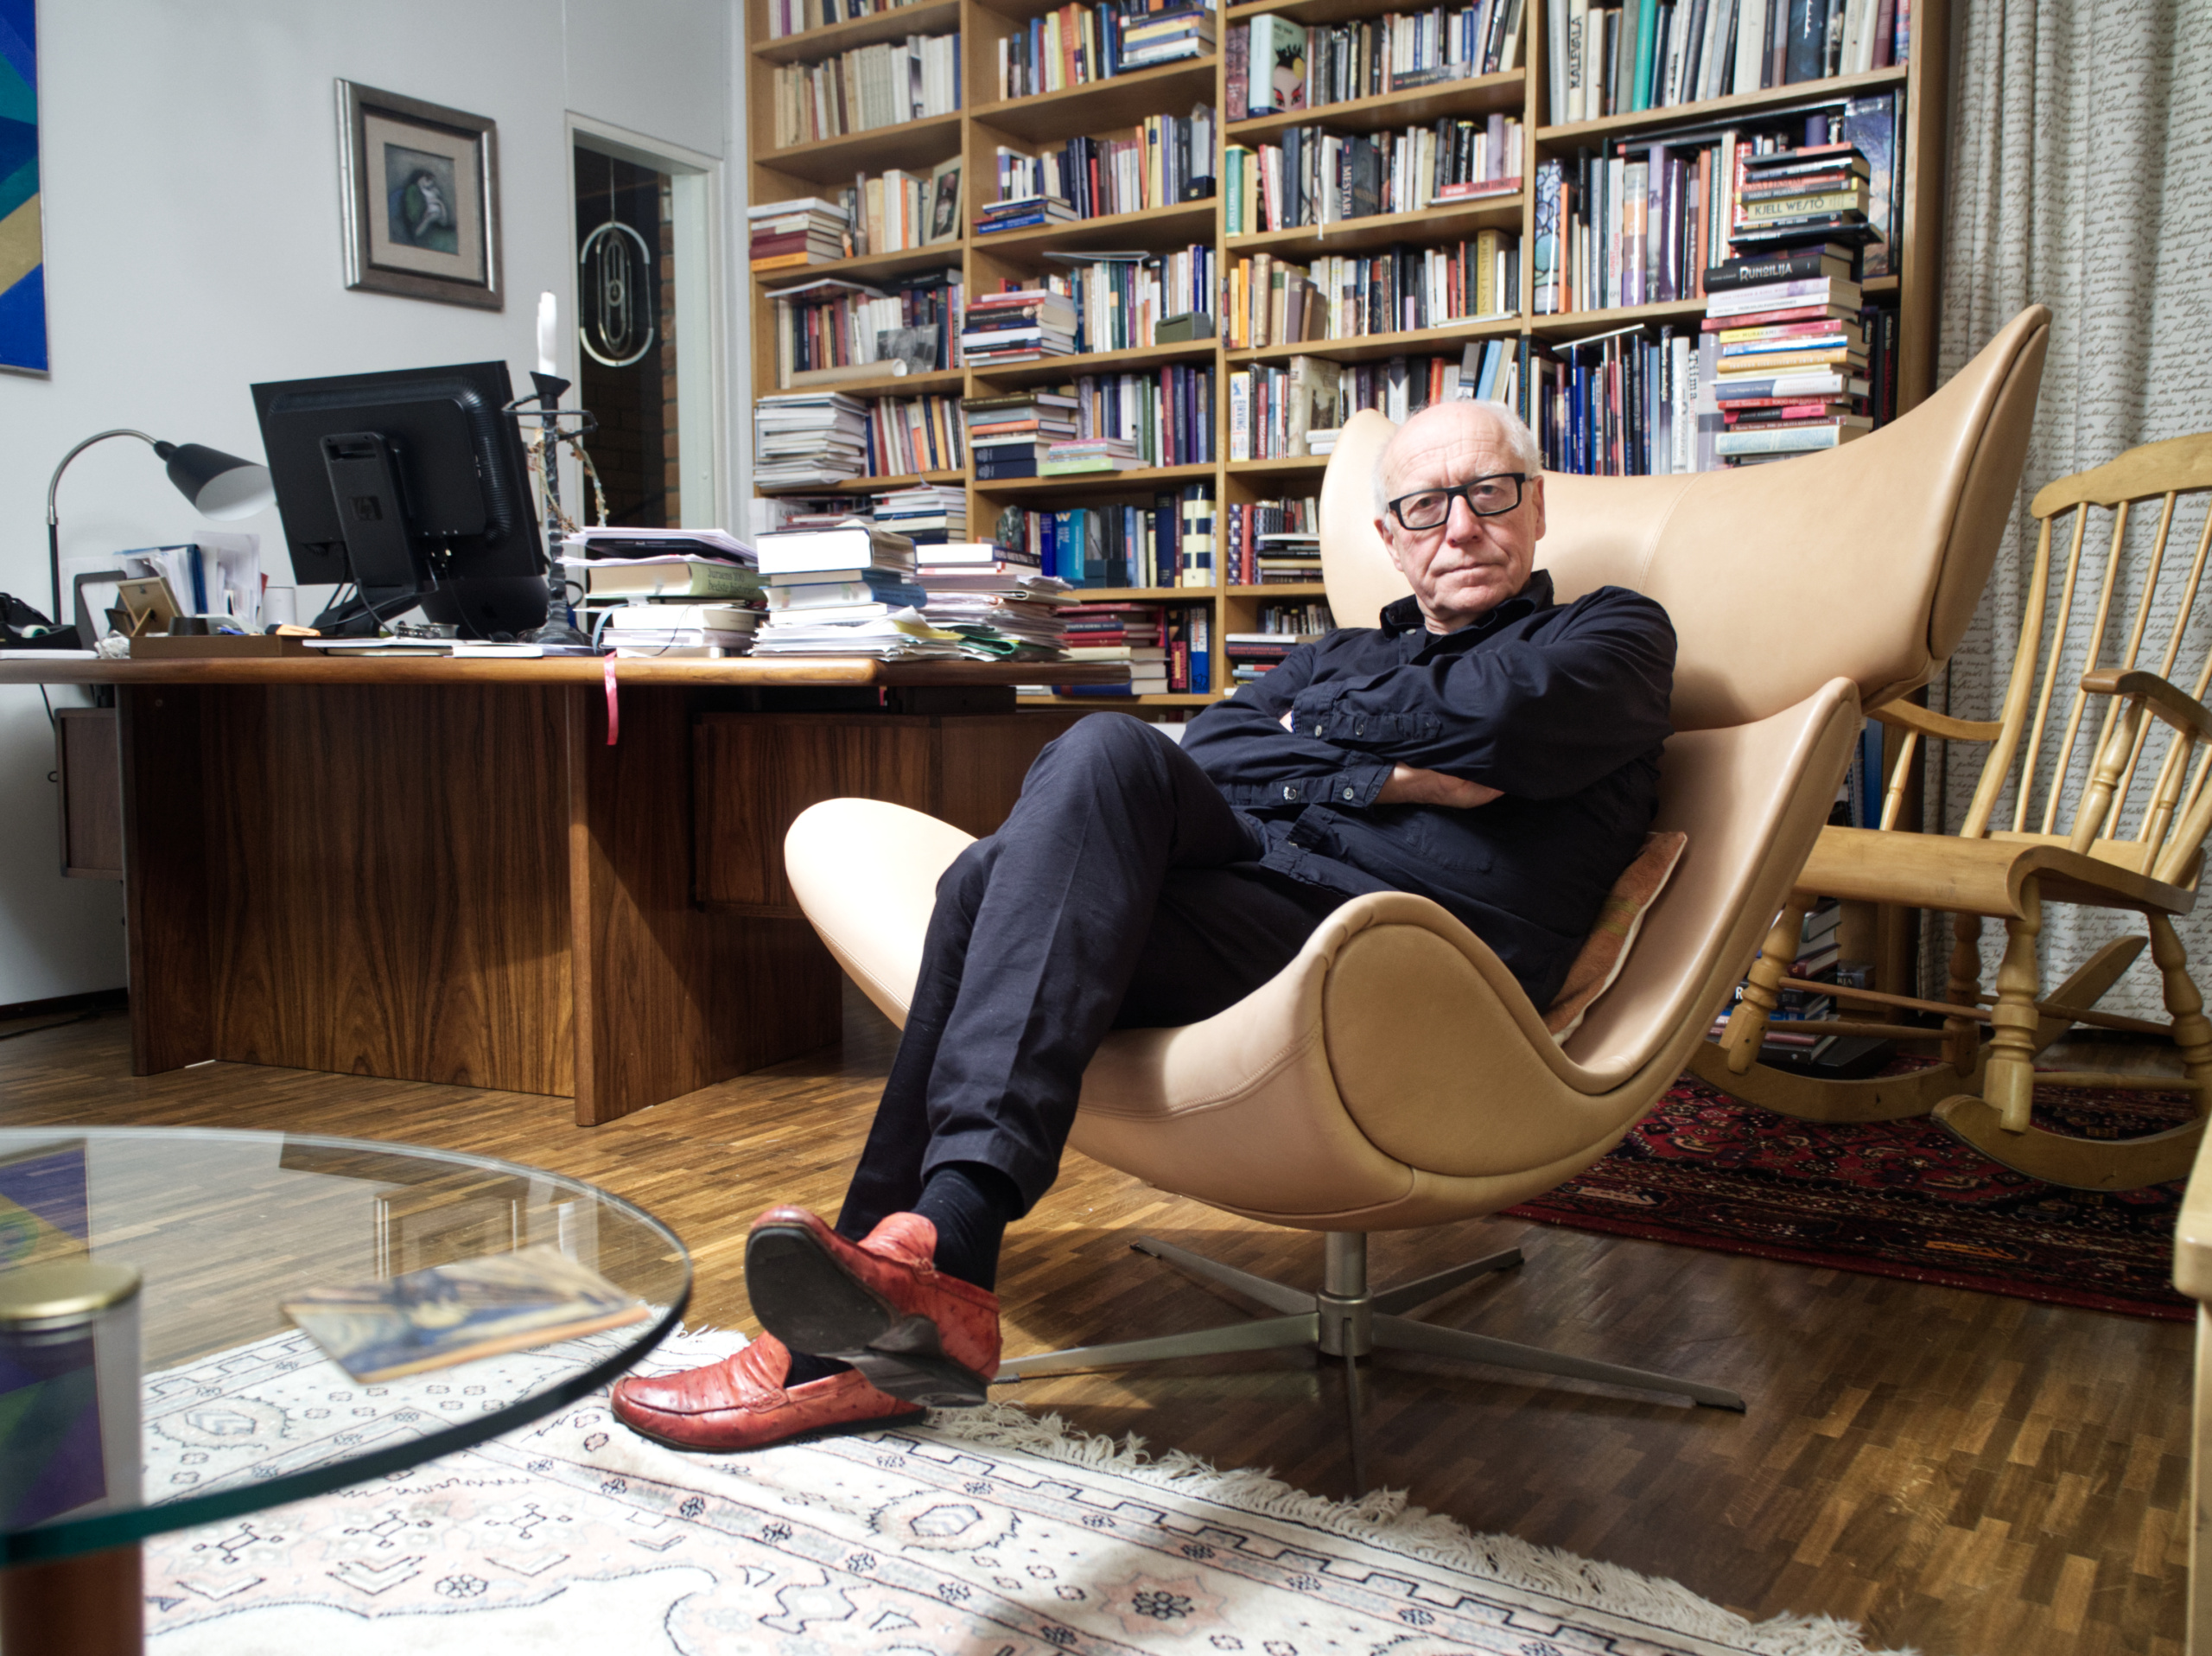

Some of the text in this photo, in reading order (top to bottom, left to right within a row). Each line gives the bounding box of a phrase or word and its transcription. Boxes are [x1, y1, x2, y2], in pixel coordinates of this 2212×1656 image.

[1570, 16, 1582, 89] KALEVALA
[1343, 166, 1351, 215] MESTARI
[1755, 203, 1783, 215] KJELL
[1739, 263, 1792, 282] RUNOILIJA
[1742, 328, 1777, 338] MURAKAMI
